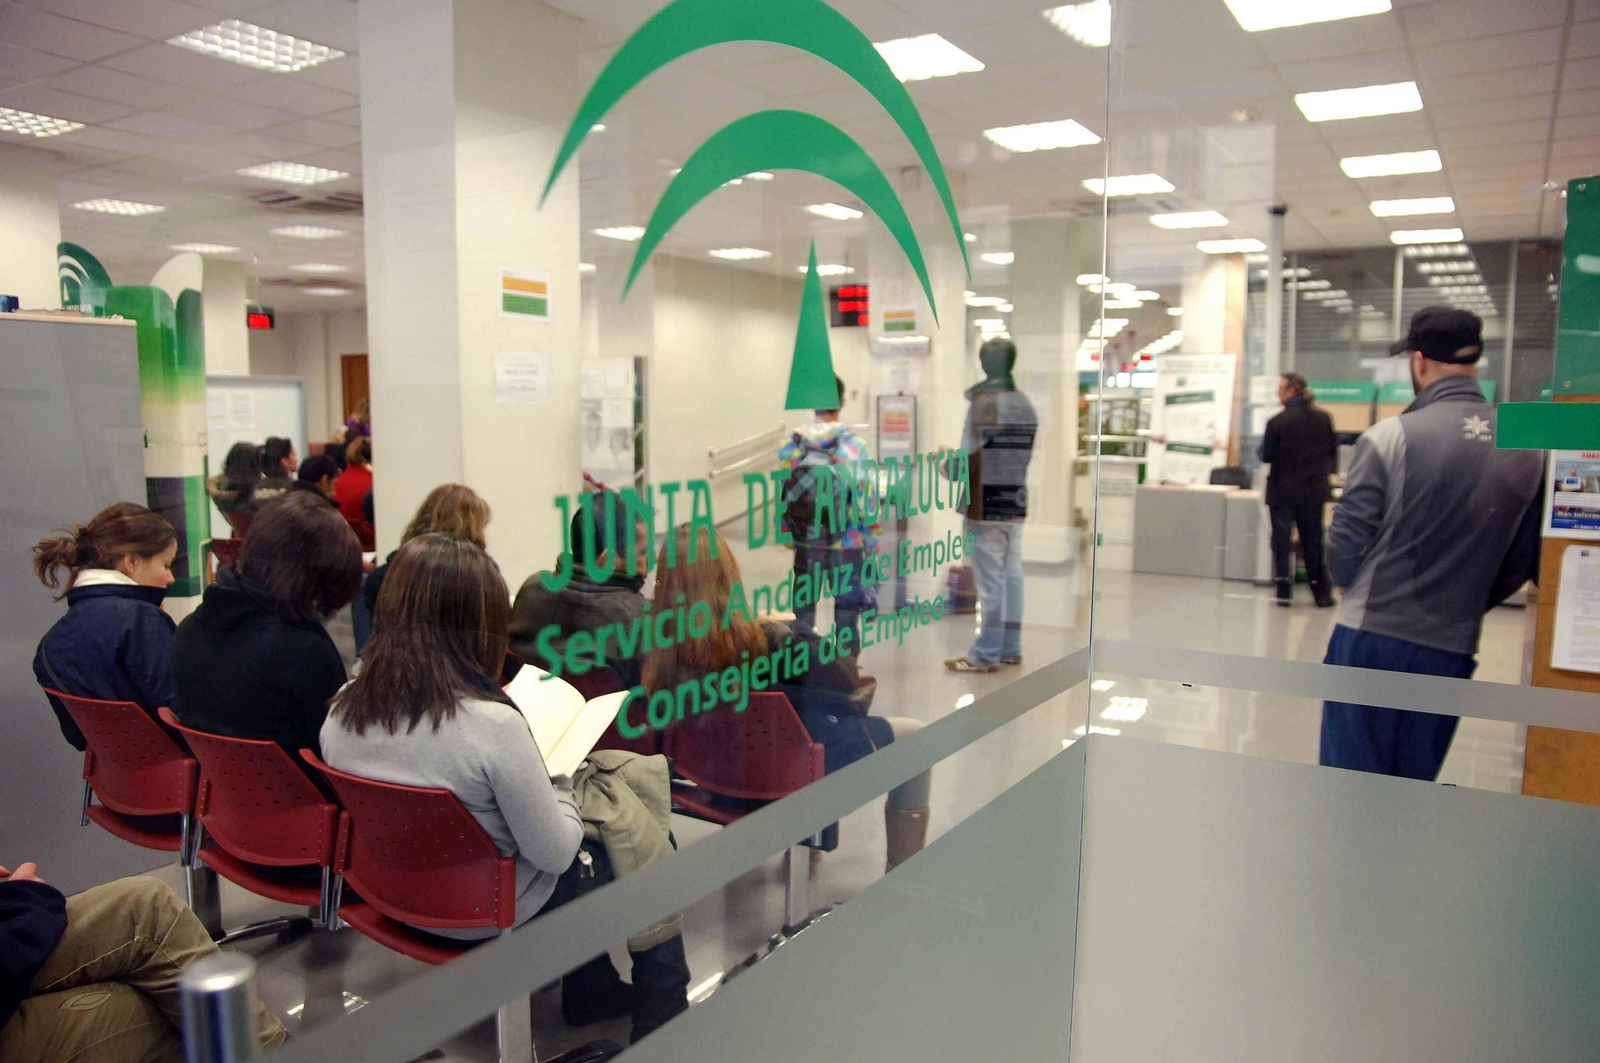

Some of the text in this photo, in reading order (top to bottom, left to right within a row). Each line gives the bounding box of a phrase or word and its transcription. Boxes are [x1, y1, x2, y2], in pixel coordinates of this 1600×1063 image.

[539, 478, 718, 593] JUNTA
[743, 467, 792, 549] DE
[536, 530, 976, 681] Servicio Andaluz de Empleo
[617, 592, 946, 740] Consejería de Empleo
